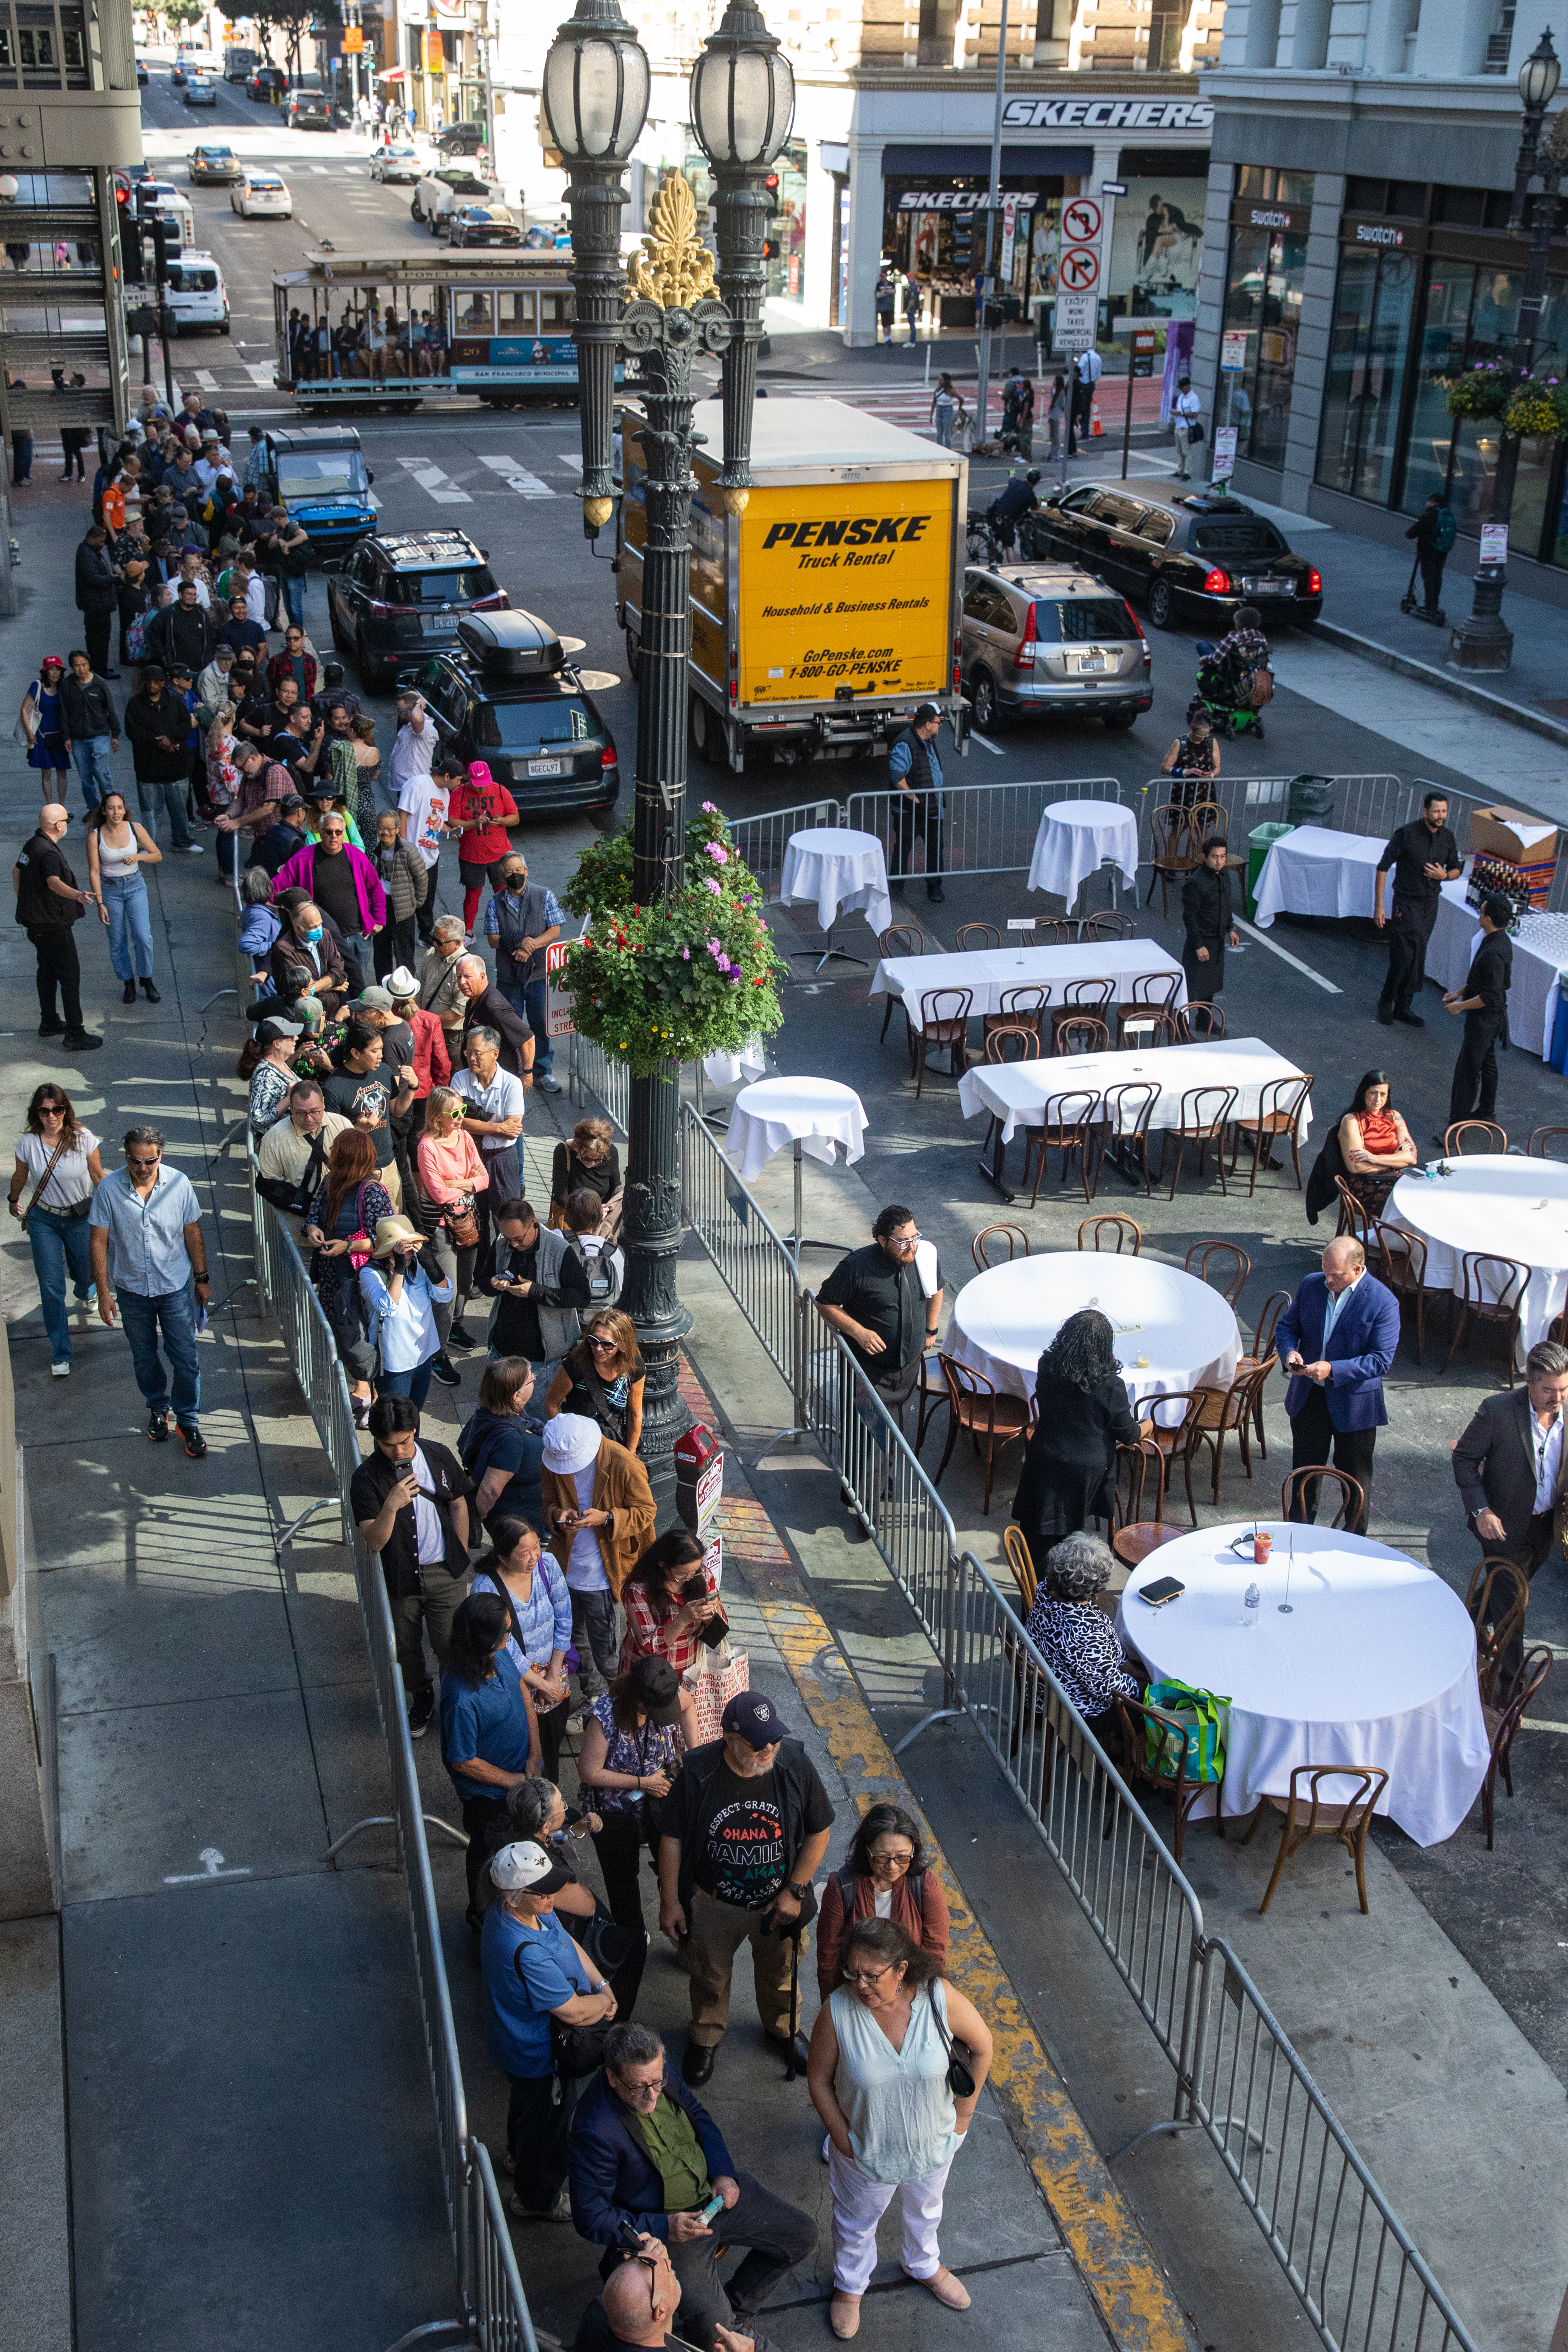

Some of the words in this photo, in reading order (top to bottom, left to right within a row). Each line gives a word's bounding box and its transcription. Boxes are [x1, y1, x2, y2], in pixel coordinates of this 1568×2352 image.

[1003, 101, 1214, 127] SKECHERS
[1251, 210, 1285, 227] swatch
[1357, 225, 1396, 244] swatch
[762, 515, 932, 550] PENSKE
[798, 553, 840, 569] Truck
[842, 550, 896, 566] Rental
[762, 603, 823, 618] Household
[823, 602, 833, 614] &
[835, 601, 887, 613] Business
[888, 597, 930, 610] Rentals
[803, 647, 894, 663] GoPenske.com
[789, 659, 903, 679] 1-800-GO-PENSKE
[530, 764, 558, 773] 8GEC497
[466, 796, 496, 811] JUST
[699, 1494, 705, 1504] NO
[705, 1474, 721, 1497] STOPPING
[694, 1688, 719, 1696] ONDON
[724, 1679, 737, 1695] PARIS
[714, 1685, 740, 1702] SHANGHAI
[697, 1709, 723, 1718] NGAPORE
[698, 1728, 723, 1739] RAMUS
[709, 1803, 740, 1837] RESPECT
[723, 1827, 768, 1840] OHANA
[744, 1864, 776, 1880] AIGA
